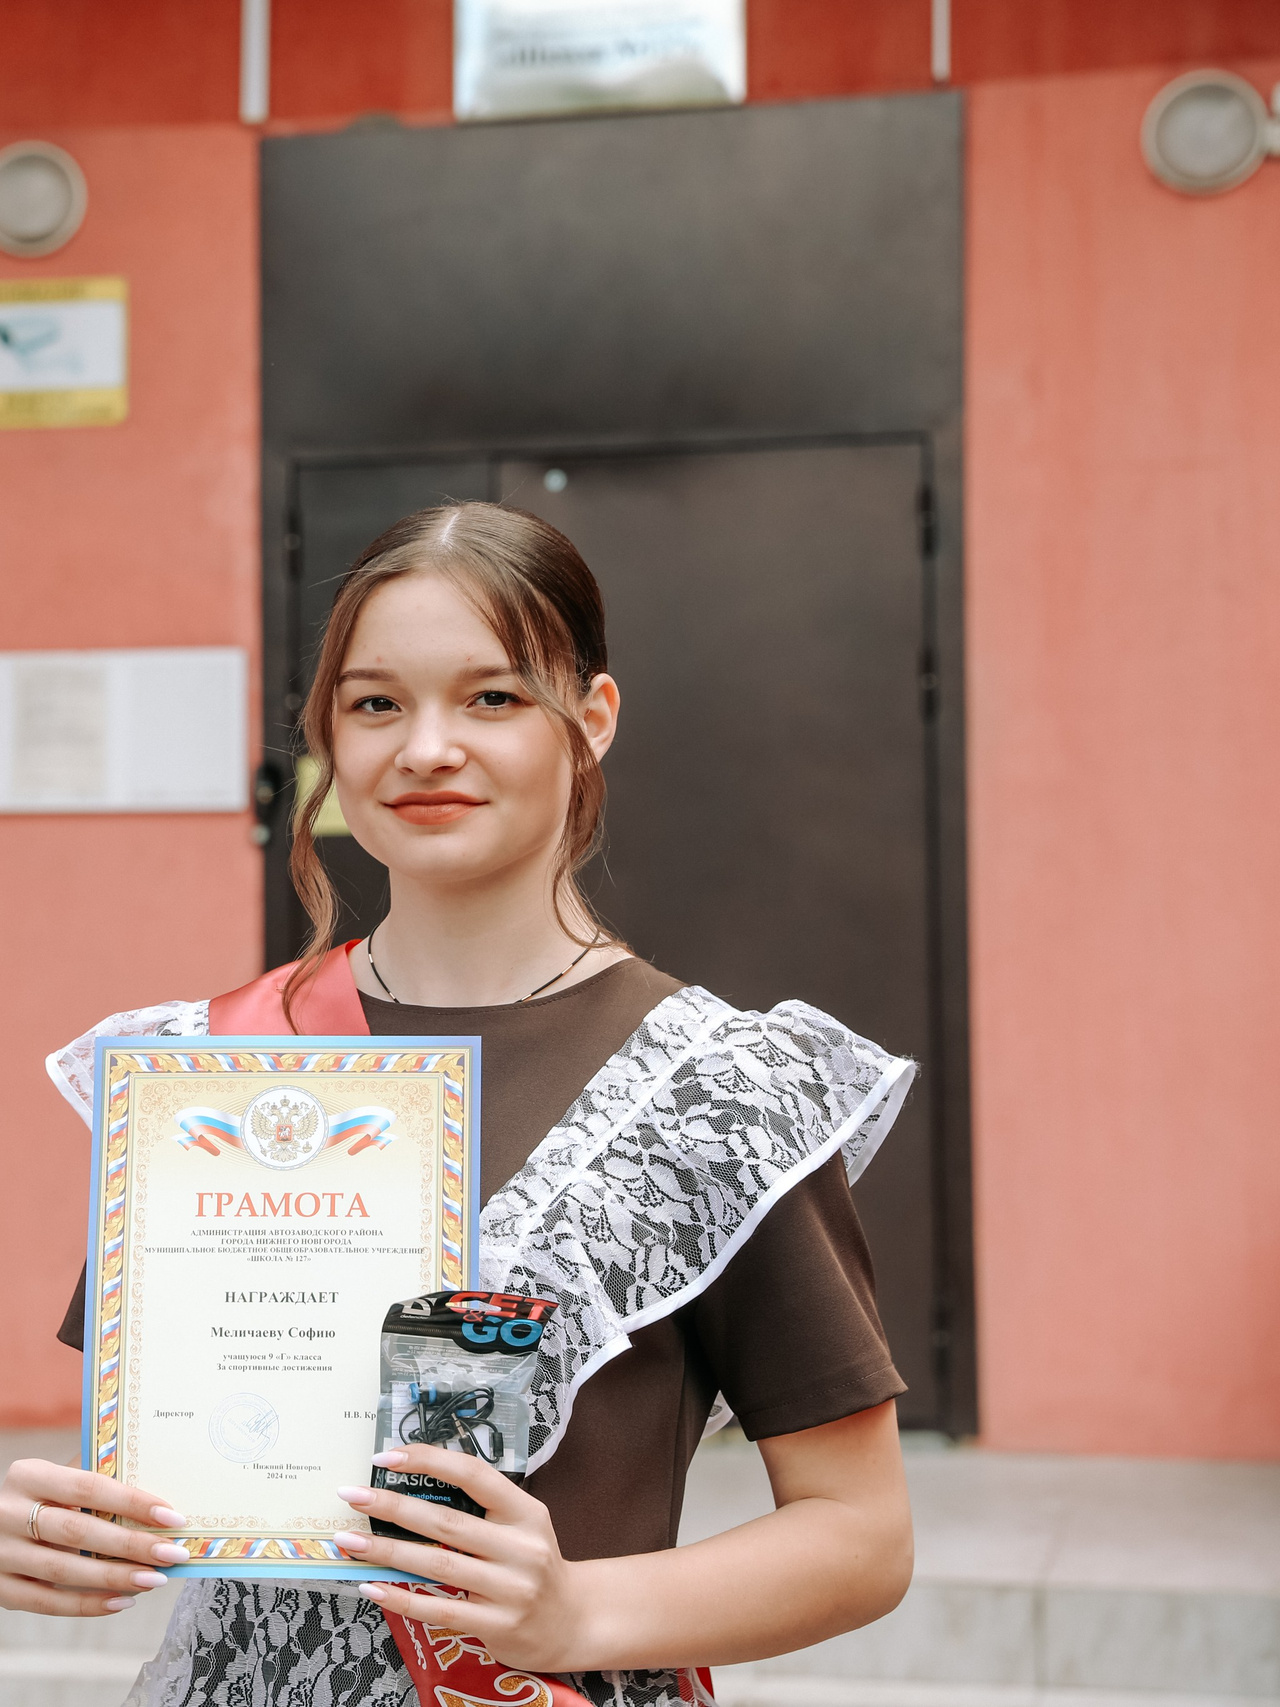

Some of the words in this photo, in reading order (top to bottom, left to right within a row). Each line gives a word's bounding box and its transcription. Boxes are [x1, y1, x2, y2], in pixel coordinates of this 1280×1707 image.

[195, 1192, 370, 1218] ГРАМОТА
[191, 1229, 266, 1237] АДМИНИСТРАЦИЯ
[268, 1229, 347, 1237] АВТОЗАВОДСКОГО
[348, 1228, 384, 1236] РАЙОНА
[225, 1291, 339, 1305] НАГРАЖДАЕТ
[449, 1291, 560, 1321] GET
[211, 1326, 284, 1340] Меличаеву
[288, 1326, 336, 1340] Софию
[461, 1315, 543, 1347] GO
[217, 1363, 226, 1371] За
[228, 1364, 280, 1372] спортивные
[153, 1409, 194, 1418] Директор
[286, 1463, 321, 1472] Новгород
[386, 1471, 434, 1487] BASIC
